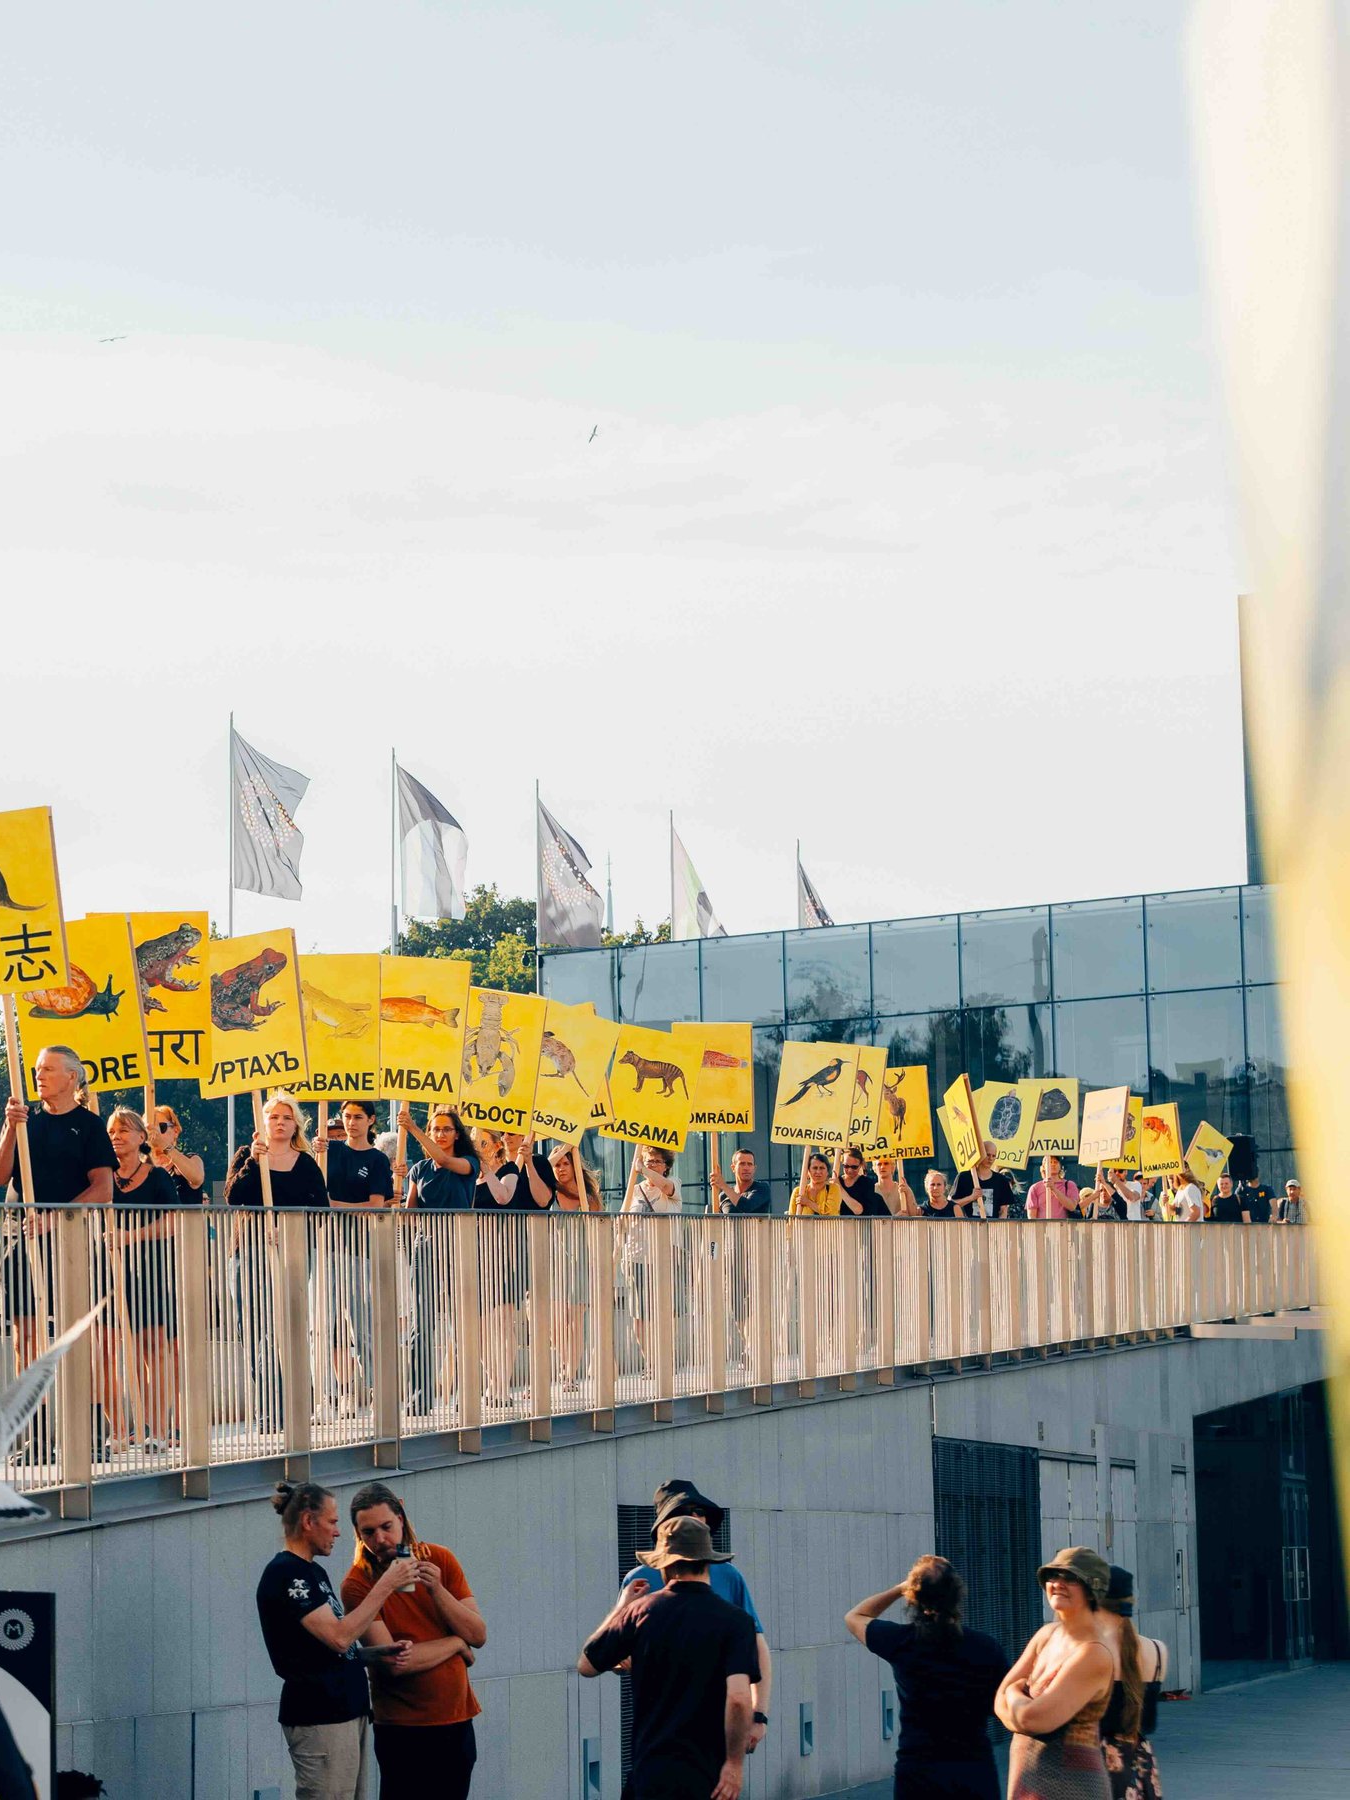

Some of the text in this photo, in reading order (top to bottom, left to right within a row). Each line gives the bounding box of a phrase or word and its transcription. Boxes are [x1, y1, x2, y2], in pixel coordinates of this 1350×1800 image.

[380, 1068, 453, 1093] МБАЛ
[458, 1101, 527, 1127] КЪОСТ
[774, 1126, 843, 1143] TOVARIŠICA
[1144, 1161, 1180, 1173] KAMARADO
